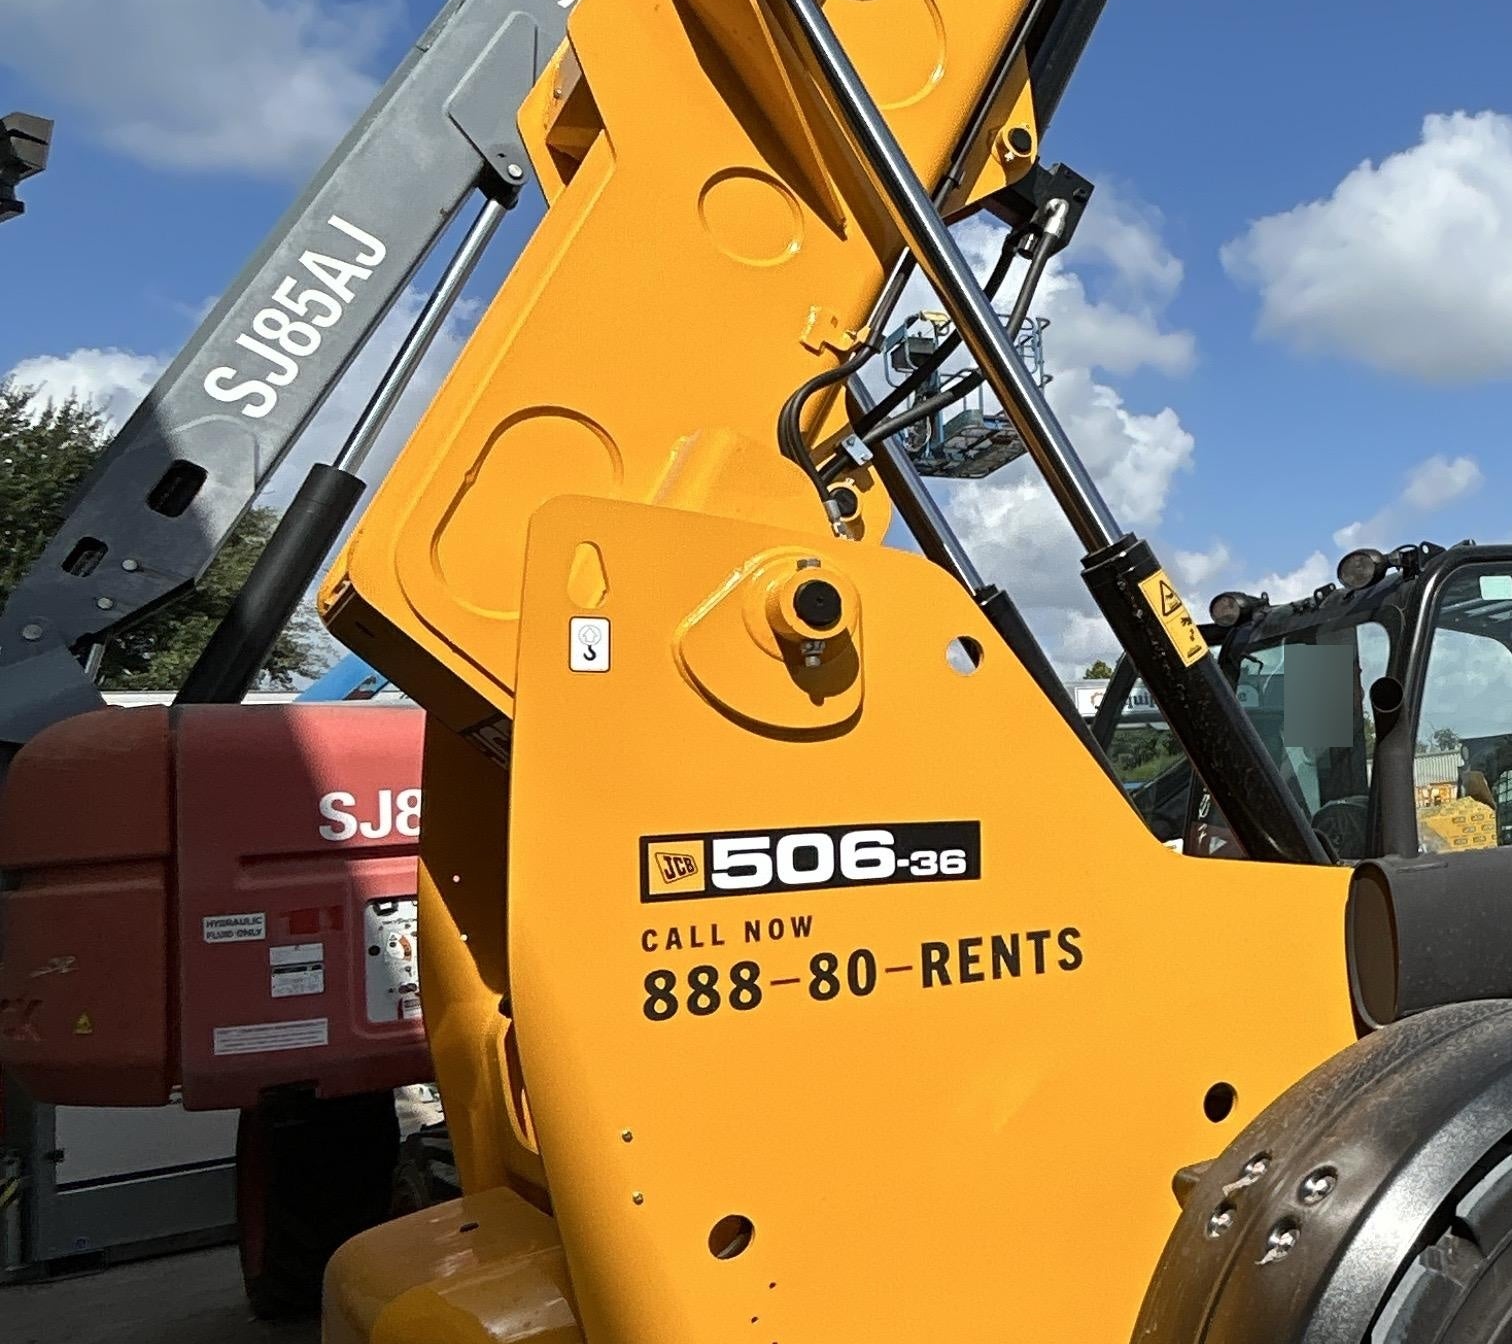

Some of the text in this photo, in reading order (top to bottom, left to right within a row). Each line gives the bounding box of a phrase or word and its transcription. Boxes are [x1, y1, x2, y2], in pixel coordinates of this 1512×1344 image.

[204, 215, 387, 419] SJ85AJ
[663, 830, 966, 889] JCB 506-36
[641, 915, 813, 953] CALL NOW
[643, 927, 1083, 1022] 888-80-RENTS
